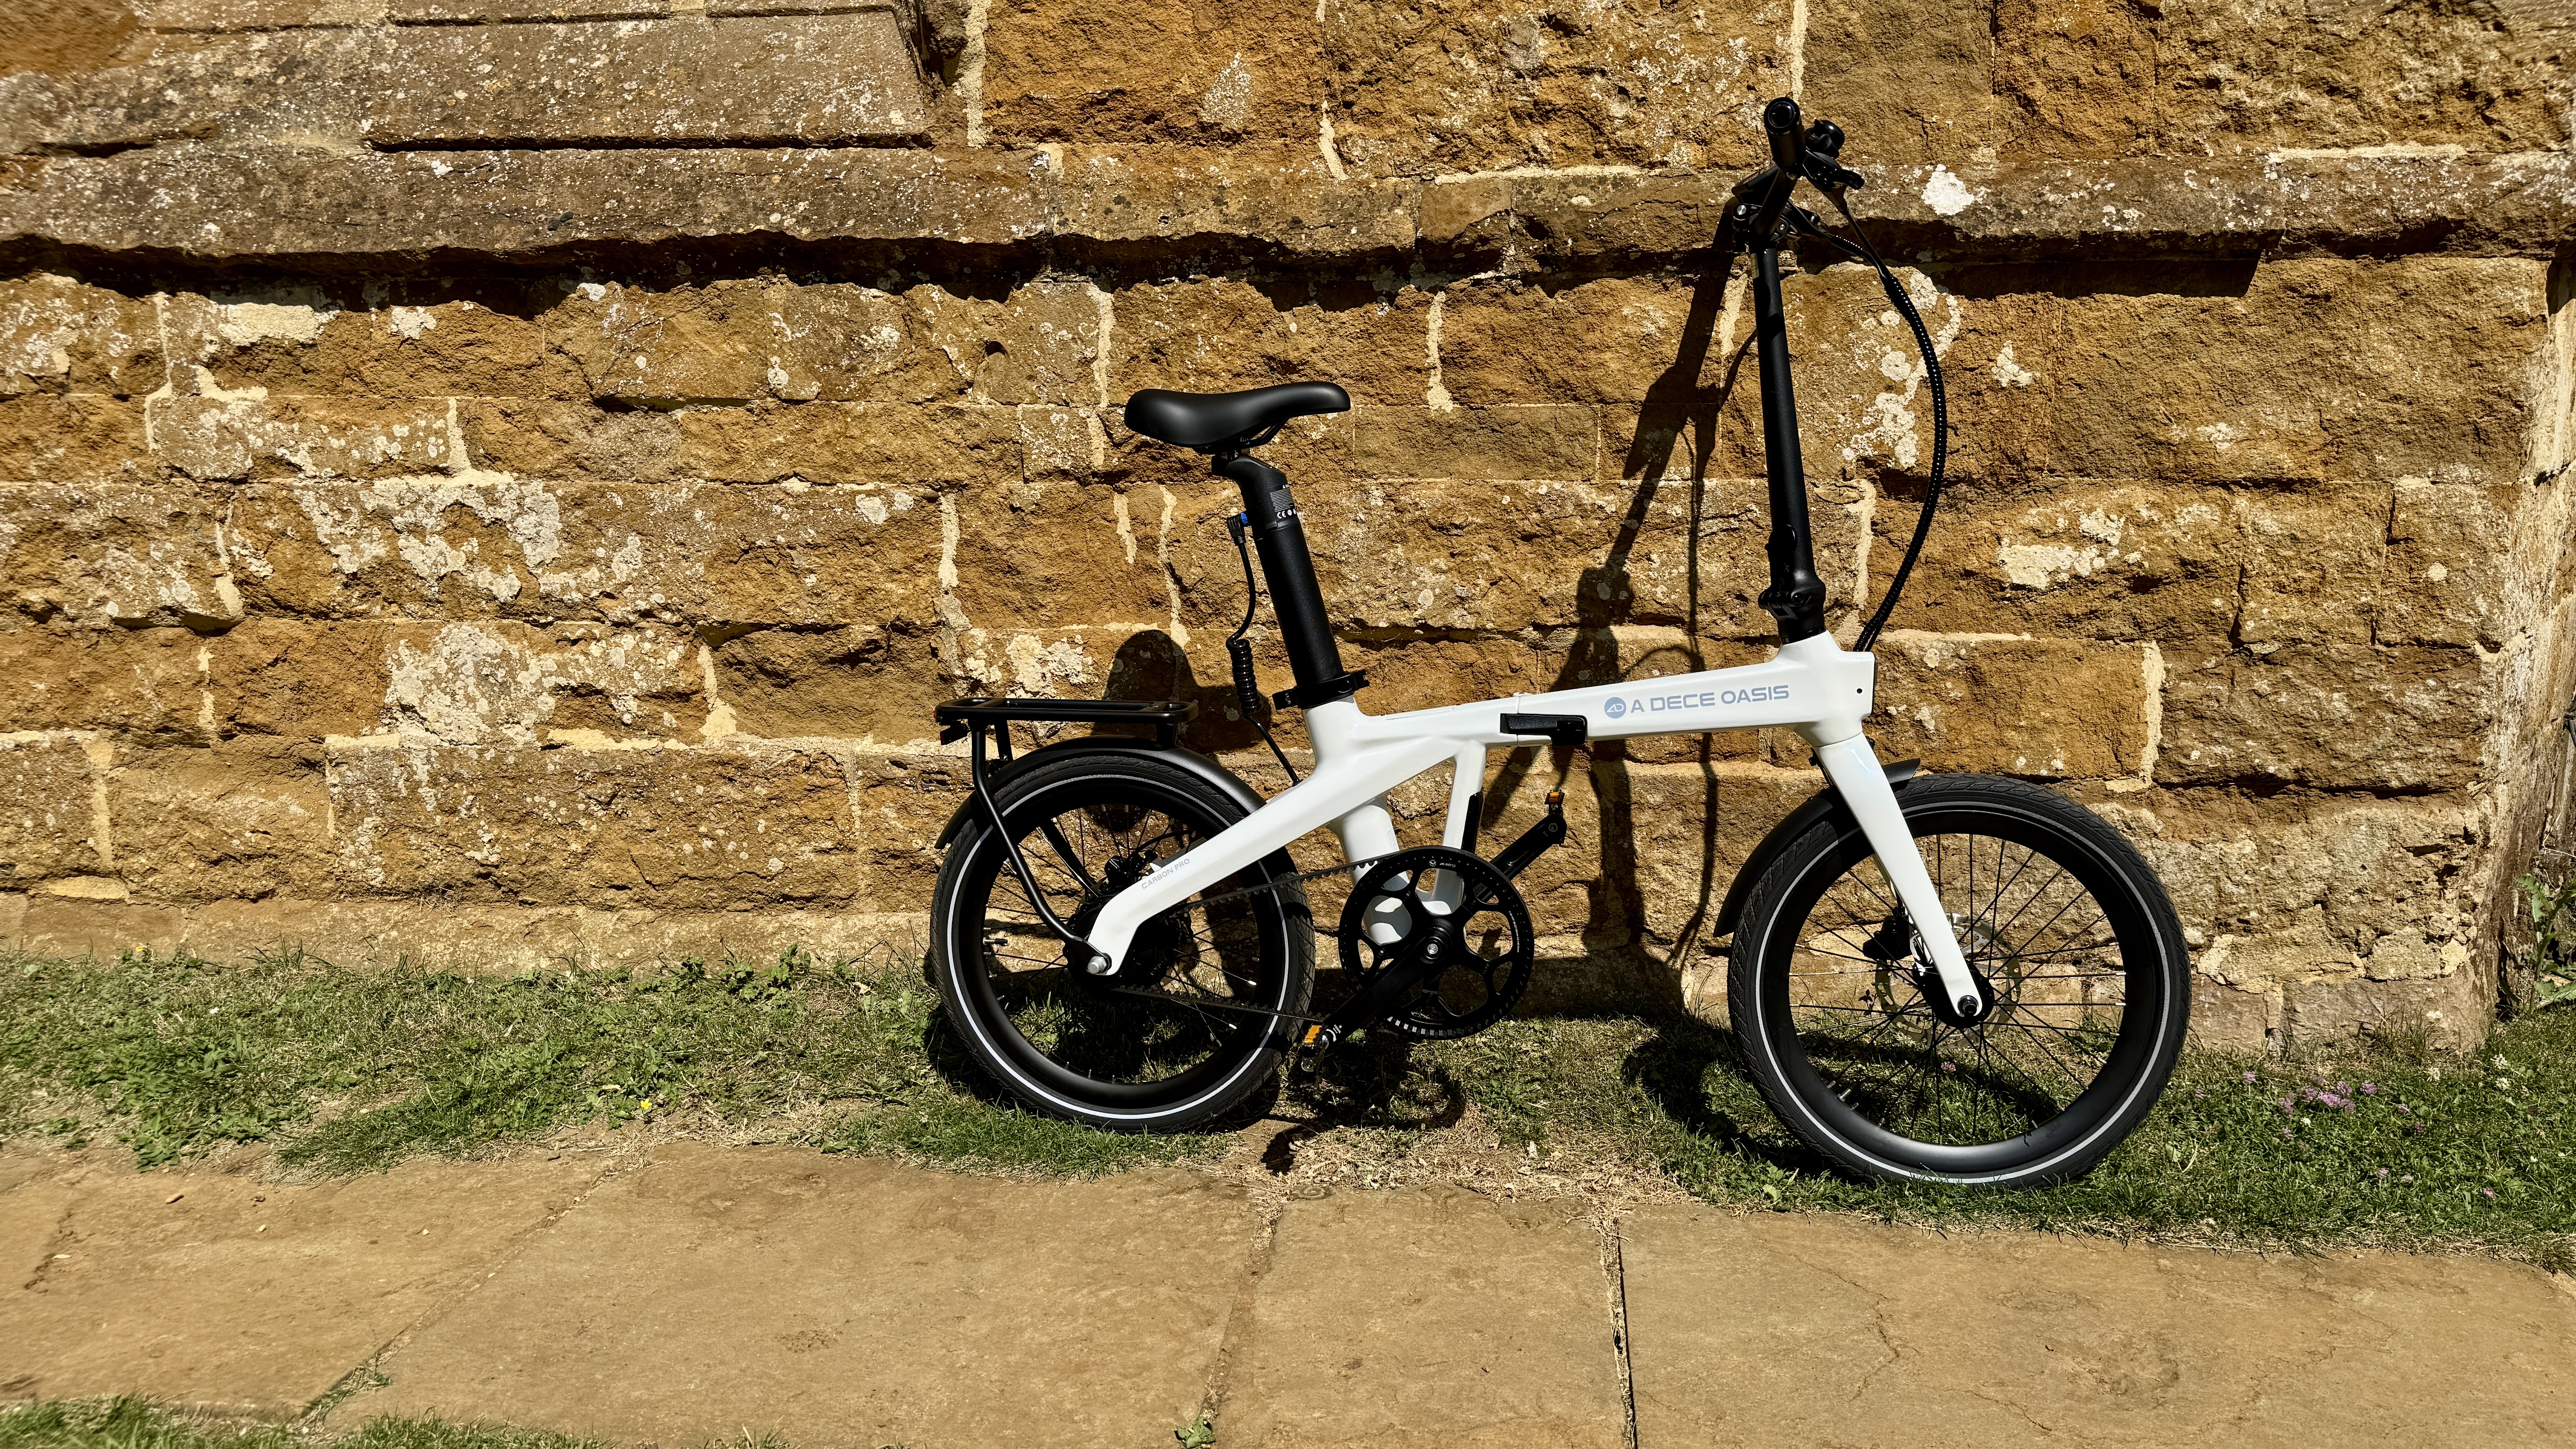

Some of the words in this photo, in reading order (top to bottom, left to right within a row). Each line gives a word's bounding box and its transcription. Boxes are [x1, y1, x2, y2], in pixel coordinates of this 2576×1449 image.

[1631, 699, 1645, 713] A
[1650, 692, 1716, 711] DECE
[1721, 685, 1789, 704] OASIS
[1141, 867, 1173, 889] CARBON
[1174, 859, 1190, 870] PRO
